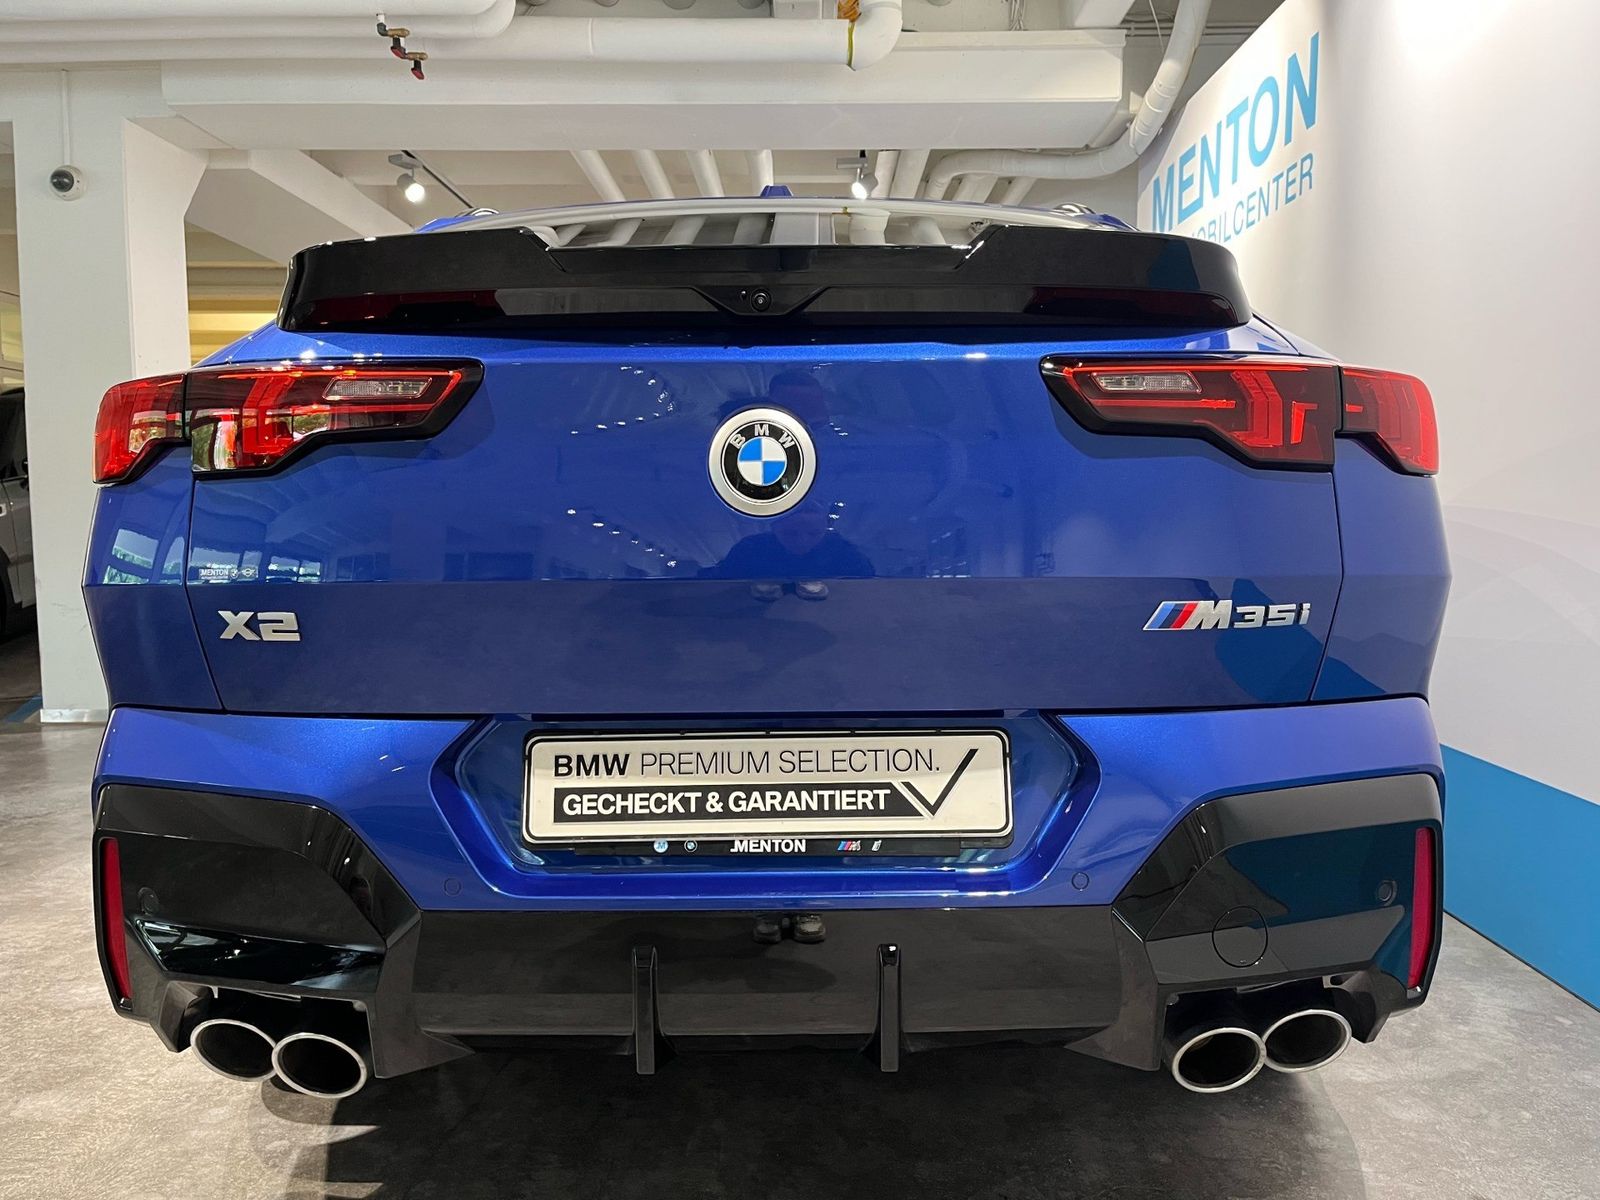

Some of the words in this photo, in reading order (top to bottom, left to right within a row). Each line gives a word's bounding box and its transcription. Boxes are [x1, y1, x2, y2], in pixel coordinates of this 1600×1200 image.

[1152, 31, 1319, 232] MENTON
[730, 423, 795, 449] BMW
[218, 610, 301, 641] X2
[1181, 599, 1311, 630] M35i
[553, 753, 630, 777] BMW
[640, 750, 770, 776] PREMIUM
[779, 748, 940, 774] SELECTION.
[562, 791, 702, 816] GECHECKT
[705, 791, 723, 813] &
[728, 789, 891, 813] GARANTIERT
[731, 839, 806, 853] MENTON
